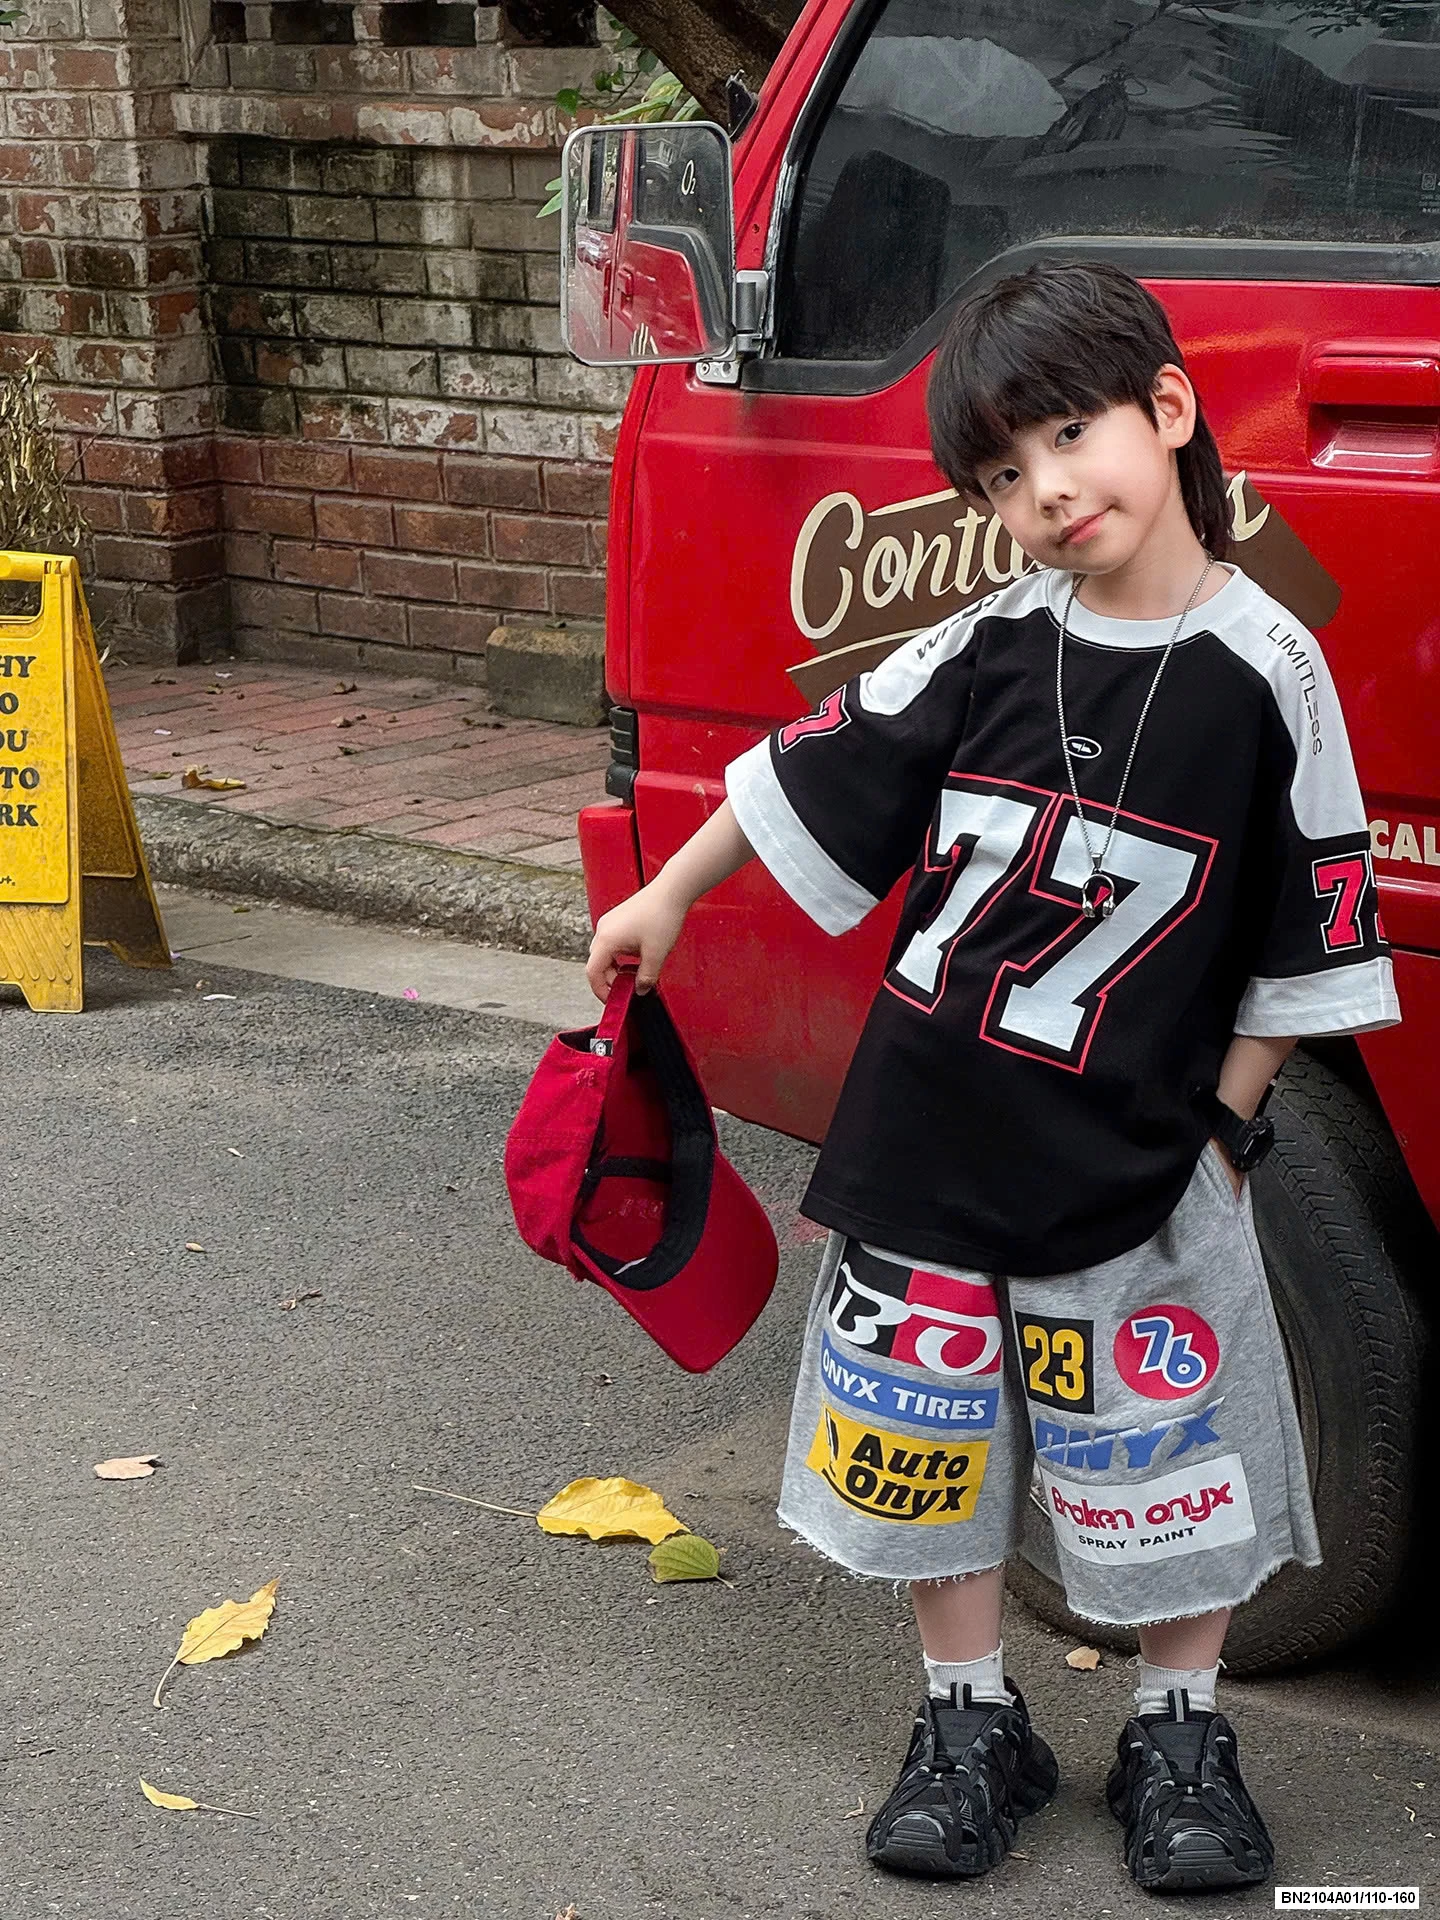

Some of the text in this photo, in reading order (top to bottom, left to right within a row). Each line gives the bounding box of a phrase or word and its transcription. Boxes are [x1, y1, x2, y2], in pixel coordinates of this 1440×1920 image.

[0, 729, 29, 752] U
[884, 771, 1218, 1074] 77
[1311, 850, 1389, 954] 7
[822, 1348, 988, 1421] ONYX TIRES
[1023, 1324, 1086, 1401] 23
[1131, 1316, 1207, 1389] 76
[850, 1433, 970, 1481] Auto
[845, 1464, 970, 1520] Onyx
[1145, 1481, 1234, 1523] onyx
[1078, 1526, 1196, 1550] SPRAY PAINT
